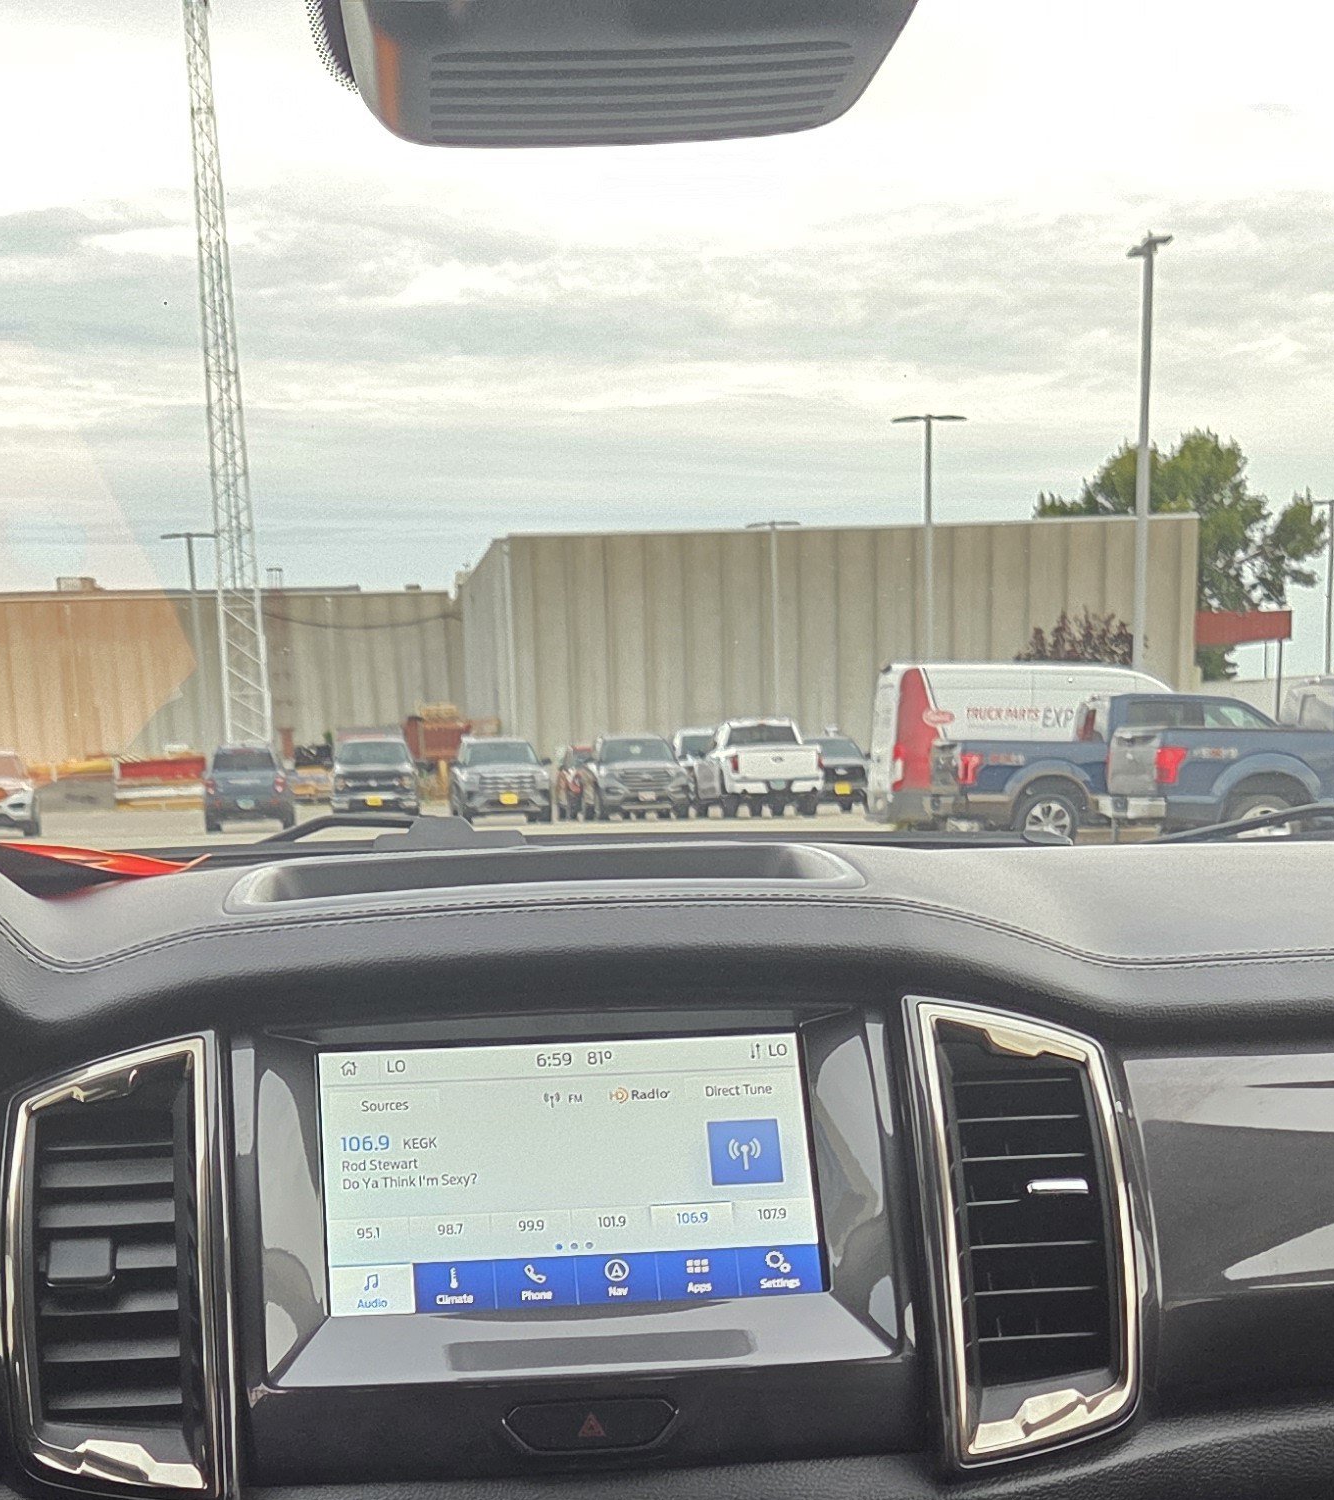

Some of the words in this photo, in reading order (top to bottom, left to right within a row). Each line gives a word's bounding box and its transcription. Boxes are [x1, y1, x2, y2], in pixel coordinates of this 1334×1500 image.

[768, 1043, 787, 1057] LO
[387, 1060, 406, 1073] LO
[536, 1052, 572, 1068] 6:59
[705, 1085, 741, 1098] Direct
[742, 1083, 773, 1096] Tune
[361, 1100, 409, 1113] Sources
[340, 1135, 390, 1152] 106.9
[403, 1137, 437, 1150] KEGK
[342, 1159, 367, 1172] Rod
[369, 1158, 418, 1171] Stewart
[342, 1178, 360, 1190] Do
[361, 1177, 379, 1189] Ya
[381, 1175, 416, 1189] Think
[418, 1175, 439, 1187] I'm
[441, 1173, 478, 1188] Sexy?
[357, 1227, 381, 1239] 95.1
[437, 1223, 464, 1236] 98.7
[518, 1219, 545, 1231] 99.9
[598, 1216, 626, 1228] 101.9
[676, 1211, 708, 1224] 106.9
[758, 1208, 787, 1220] 107.9
[357, 1298, 388, 1309] Audio
[436, 1293, 474, 1305] Climate
[521, 1290, 553, 1301] Phone
[608, 1286, 628, 1297] Nav
[687, 1281, 712, 1293] Apps
[760, 1277, 801, 1289] Settings
